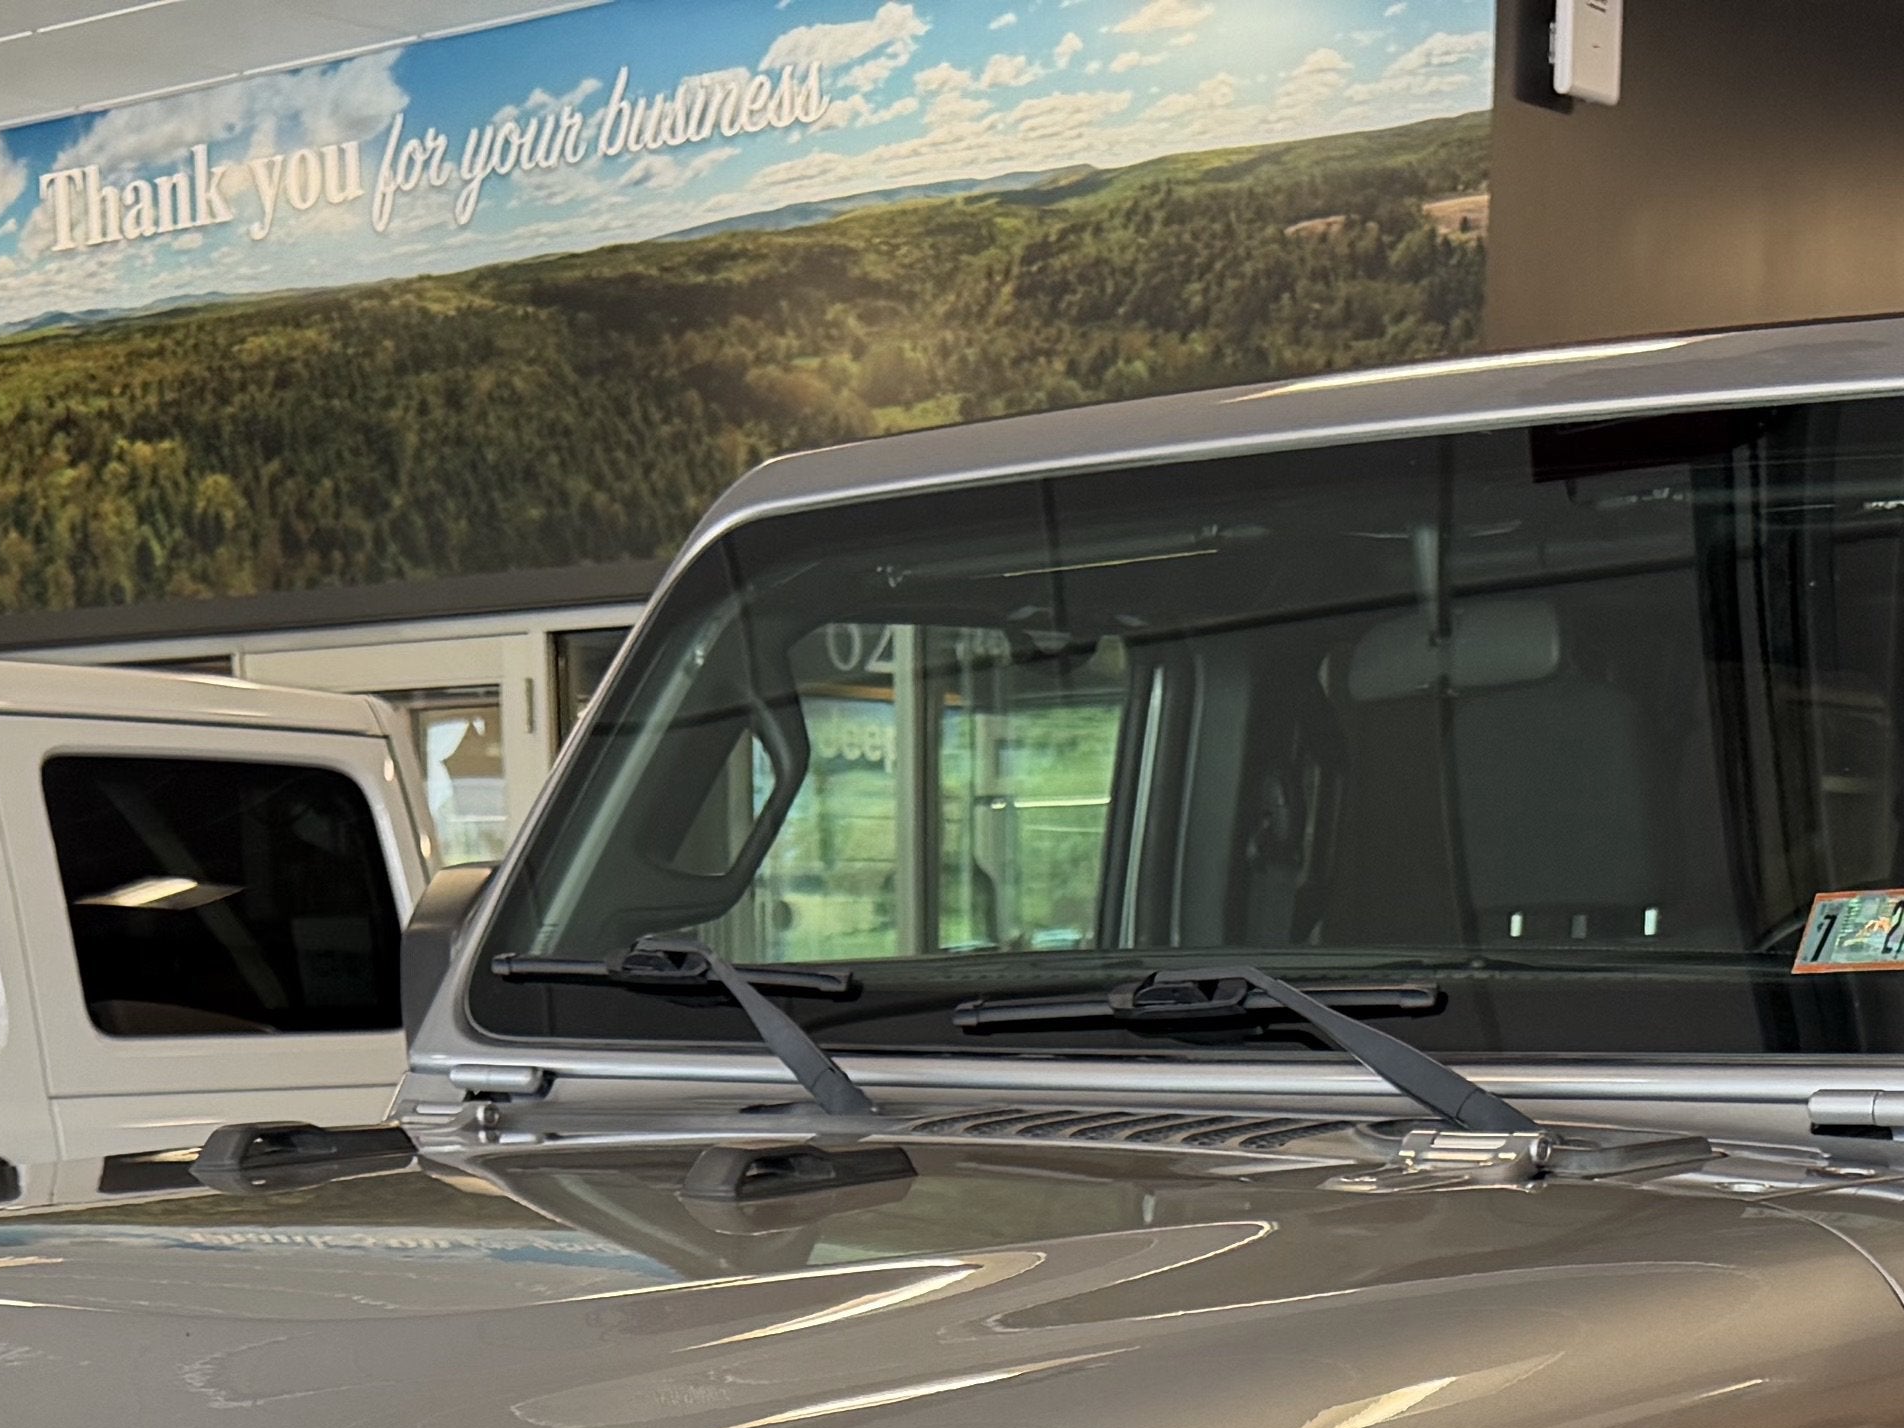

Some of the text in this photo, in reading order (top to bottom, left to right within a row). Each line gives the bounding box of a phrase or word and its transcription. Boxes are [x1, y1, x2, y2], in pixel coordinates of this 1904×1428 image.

[39, 61, 833, 252] Thank you for your business
